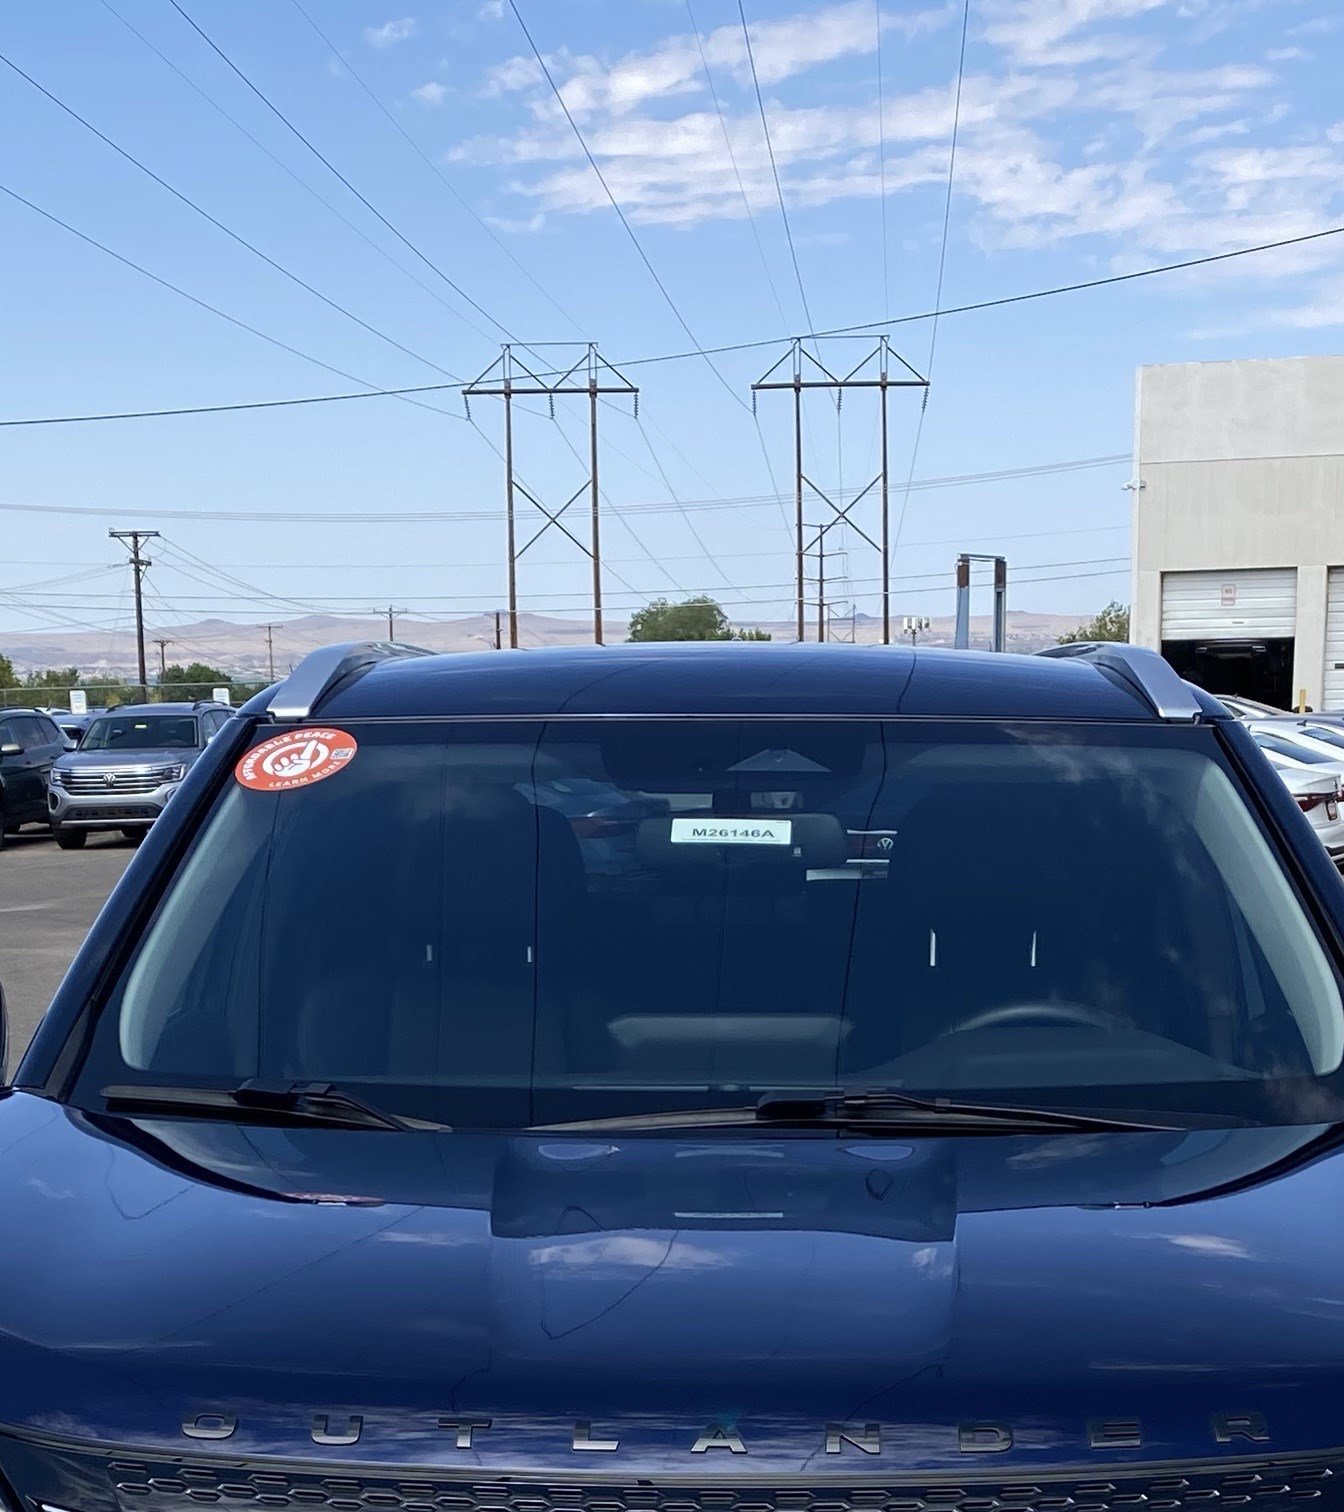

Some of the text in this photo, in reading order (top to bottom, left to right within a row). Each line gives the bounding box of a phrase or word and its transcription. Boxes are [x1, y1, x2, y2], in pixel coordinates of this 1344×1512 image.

[294, 731, 337, 740] PEACE
[268, 760, 341, 788] LEARN MORE
[692, 827, 775, 838] M26146A
[181, 1409, 1271, 1454] OUTLANDER
